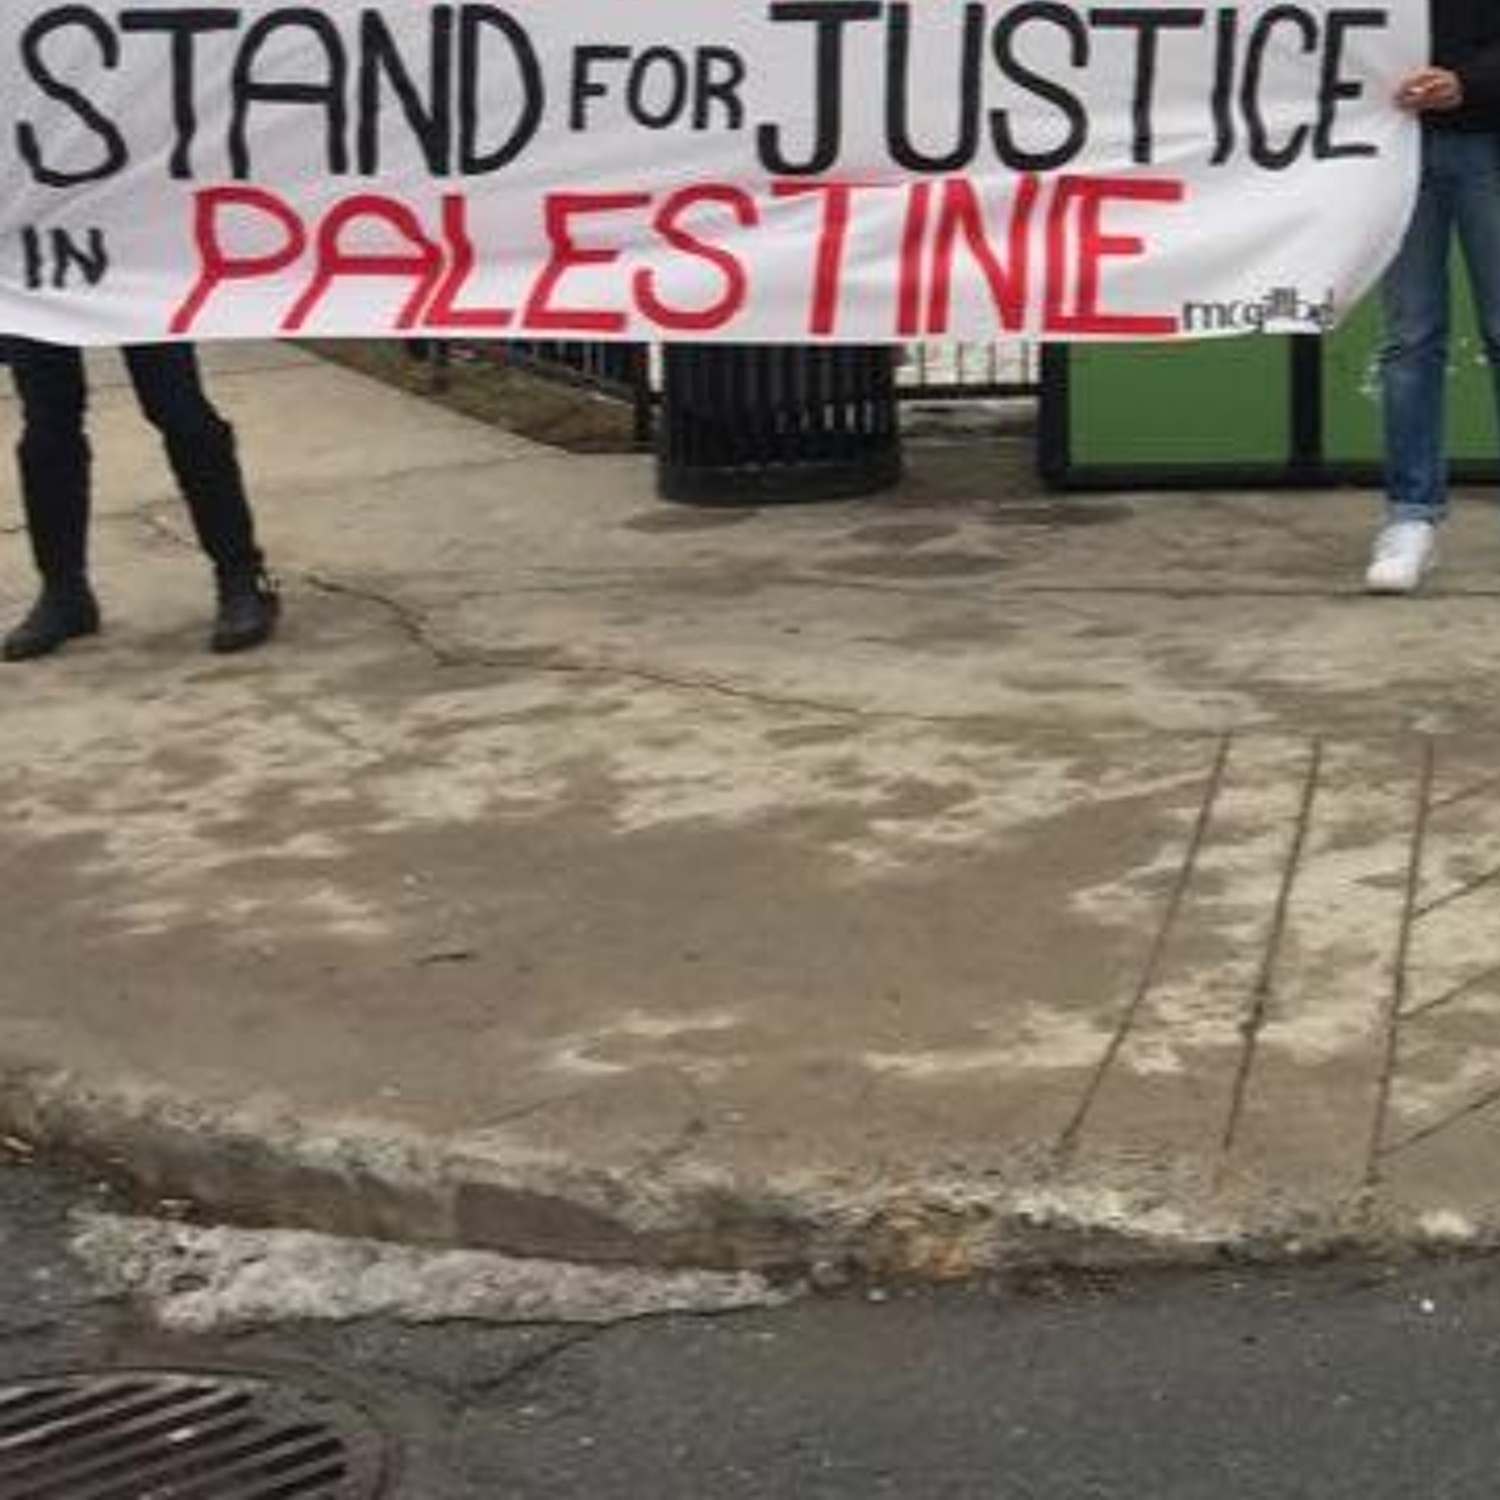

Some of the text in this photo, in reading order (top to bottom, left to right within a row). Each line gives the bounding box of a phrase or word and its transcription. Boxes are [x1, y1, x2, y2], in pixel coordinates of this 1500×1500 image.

[16, 1, 1389, 187] STAND FOR JUSTICE
[21, 174, 1184, 336] IN PALESTINE
